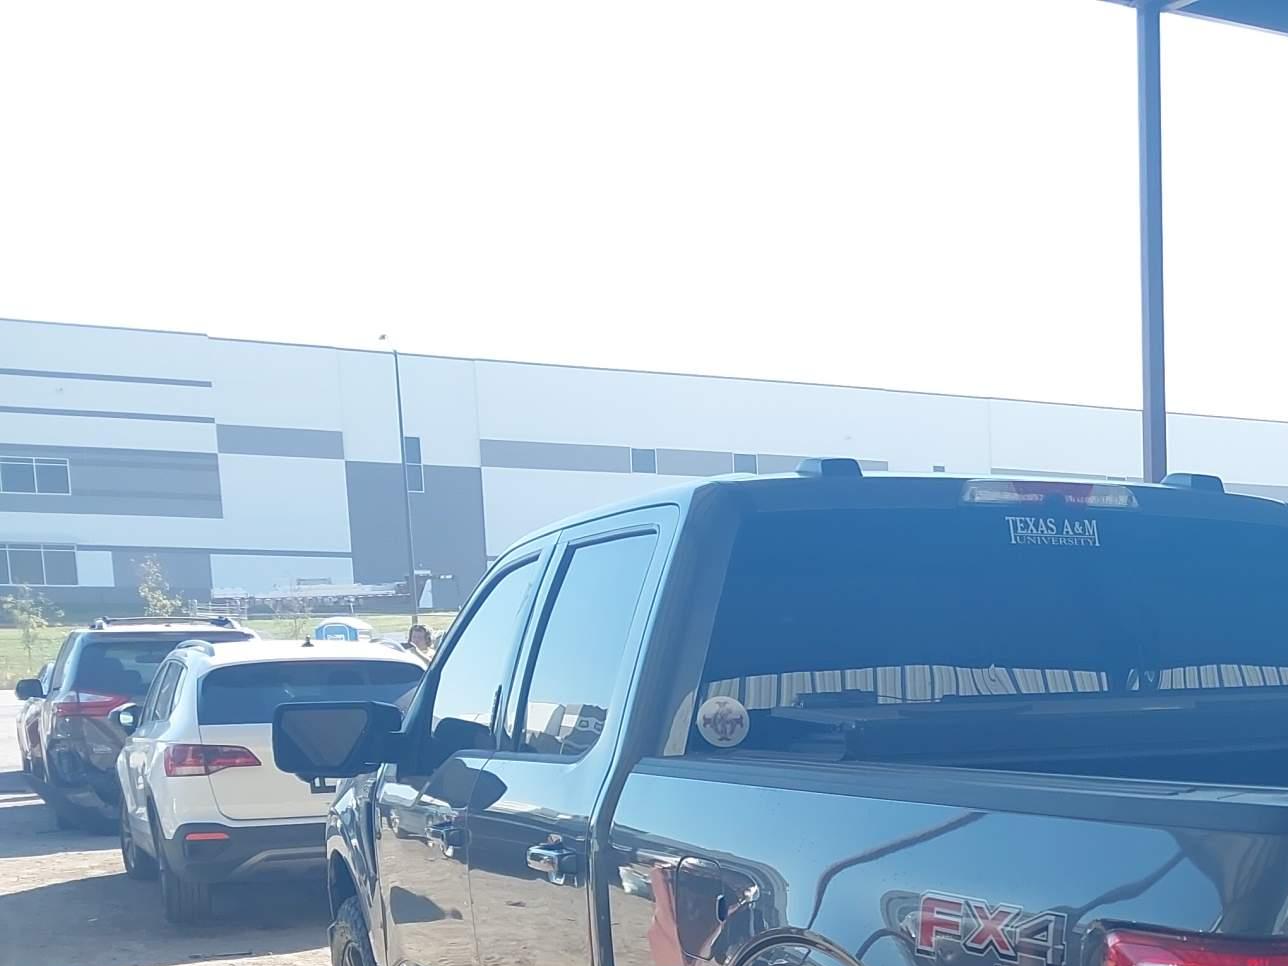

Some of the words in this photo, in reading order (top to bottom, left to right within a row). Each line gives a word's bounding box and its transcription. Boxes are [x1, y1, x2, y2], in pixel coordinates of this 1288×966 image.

[1005, 516, 1057, 544] TEXAS
[1063, 519, 1100, 546] A&M
[1017, 535, 1095, 546] UNIVERSITY
